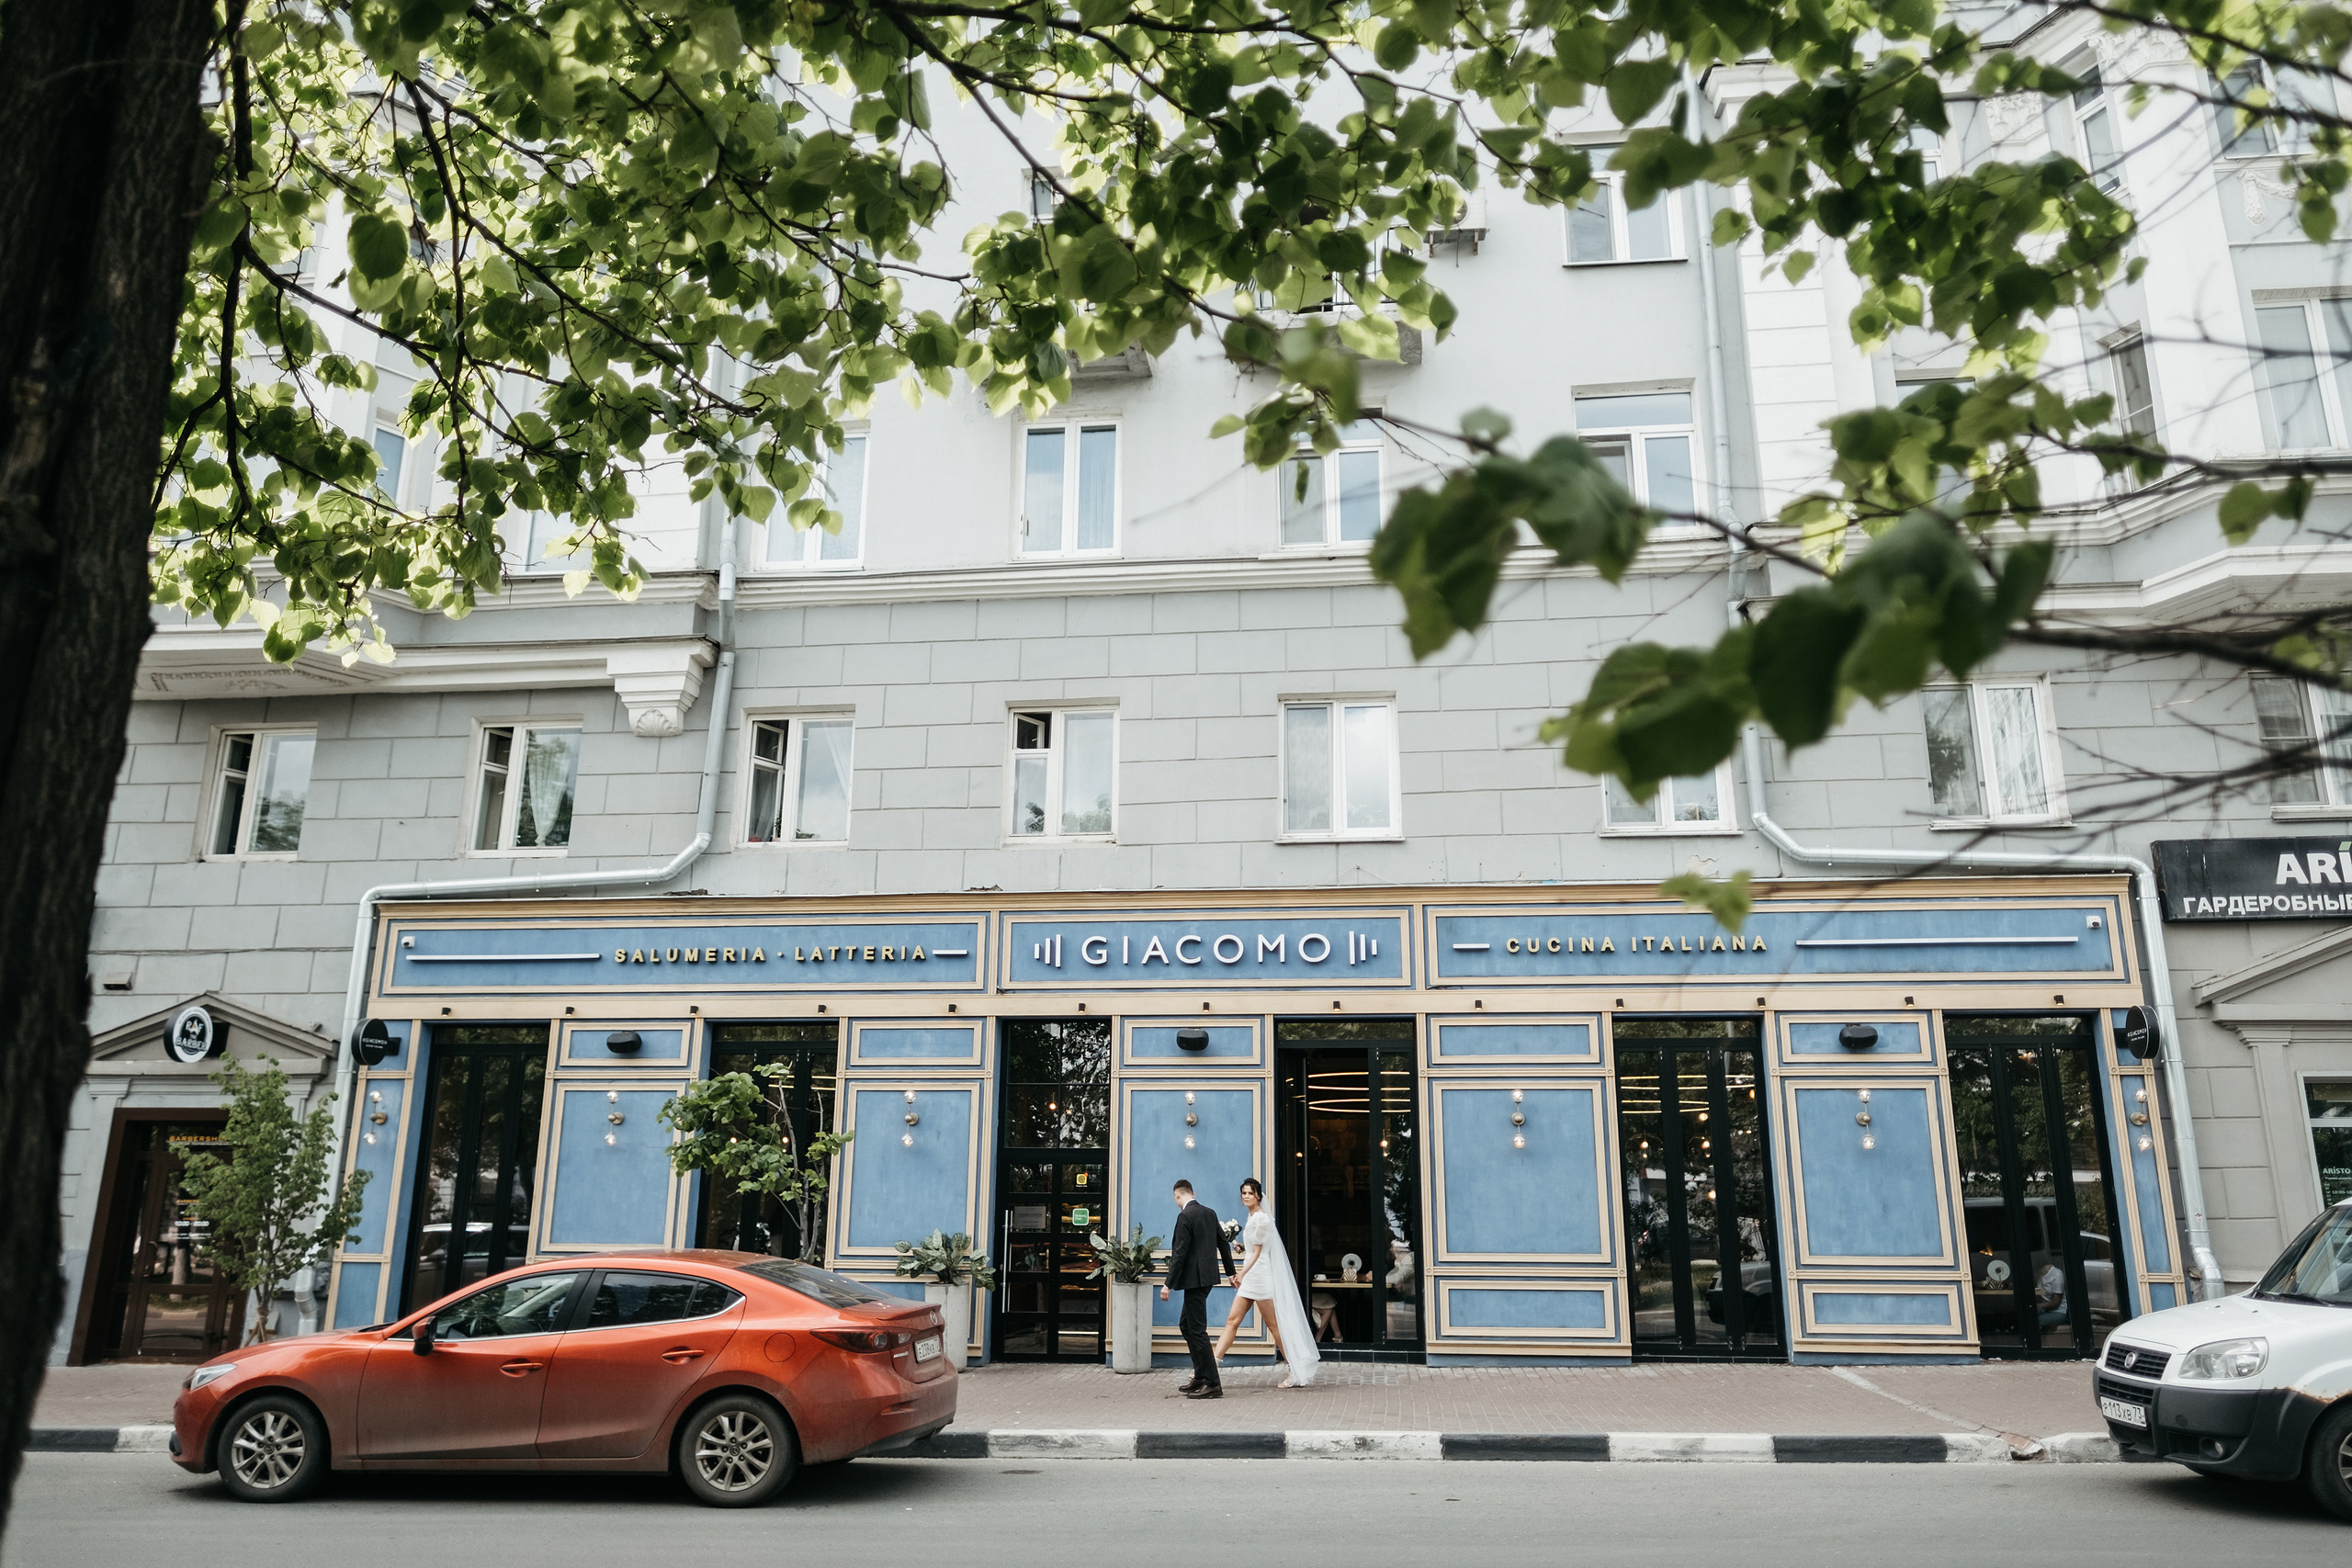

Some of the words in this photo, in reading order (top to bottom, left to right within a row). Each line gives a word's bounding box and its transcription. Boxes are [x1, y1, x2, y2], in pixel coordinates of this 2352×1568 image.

[614, 946, 766, 964] SALUMERIA
[794, 944, 926, 962] LATTERIA
[1081, 932, 1331, 965] GIACOMO
[1506, 936, 1615, 953] CUCINA
[1631, 935, 1767, 953] ITALIANA
